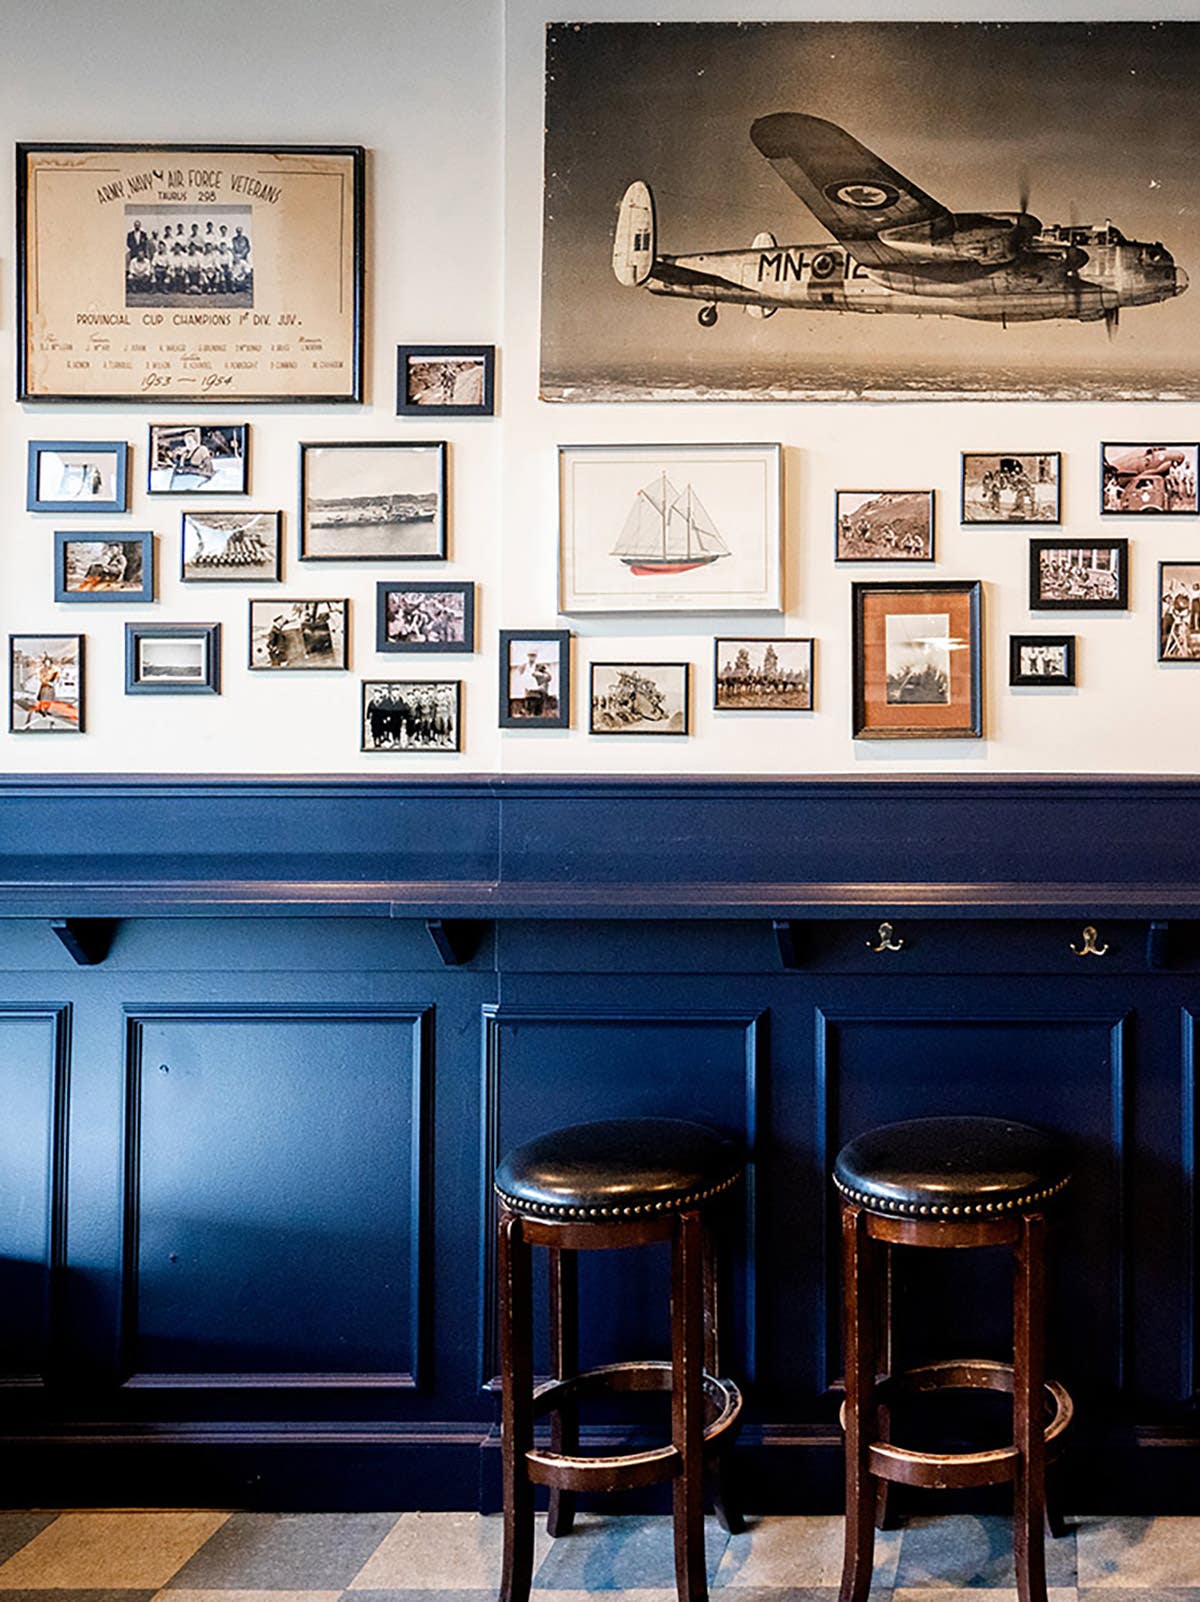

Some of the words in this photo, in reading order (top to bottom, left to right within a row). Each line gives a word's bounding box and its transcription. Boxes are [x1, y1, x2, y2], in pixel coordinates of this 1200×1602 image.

[168, 169, 185, 188] AIR
[189, 169, 223, 189] FORCE
[231, 174, 282, 204] VETERANS
[158, 191, 187, 201] TAURUS
[77, 313, 130, 325] PROVINCIAL
[142, 313, 164, 325] CUP
[172, 313, 231, 325] CHAMPIONS
[141, 373, 172, 391] 1953
[201, 373, 233, 391] 1954
